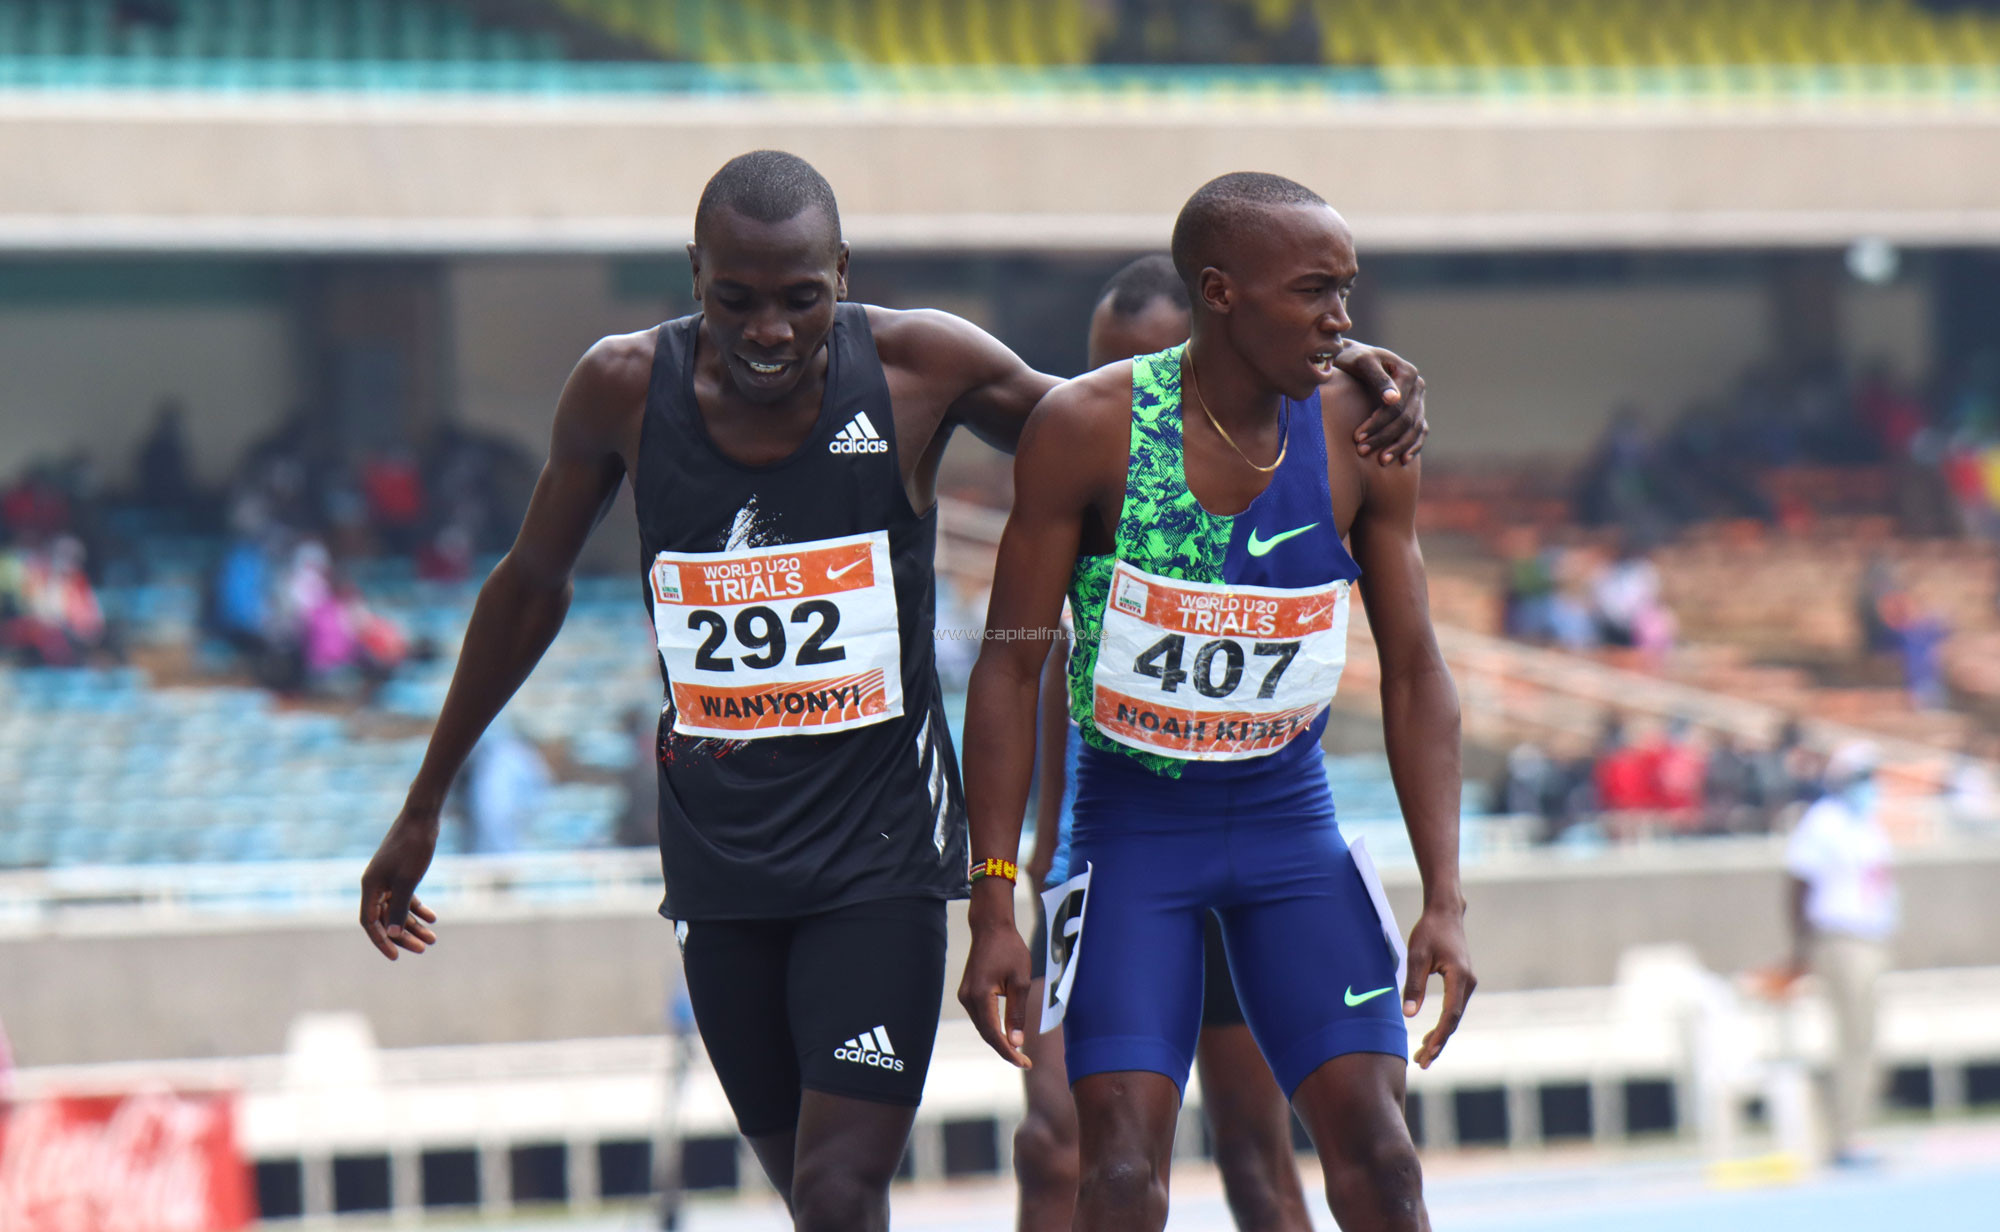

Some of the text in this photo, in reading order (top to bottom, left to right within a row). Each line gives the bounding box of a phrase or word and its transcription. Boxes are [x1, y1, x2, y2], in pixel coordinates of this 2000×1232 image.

[828, 438, 889, 454] adidas
[703, 557, 801, 579] WORLD U20
[704, 572, 804, 603] TRIALS
[1179, 593, 1278, 614] WORLD U20
[687, 599, 847, 672] 292
[1177, 607, 1276, 635] TRIALS
[1133, 633, 1302, 699] 407
[699, 684, 860, 718] WANYONYI
[1116, 703, 1207, 741] NOAH
[833, 1047, 905, 1072] adidas
